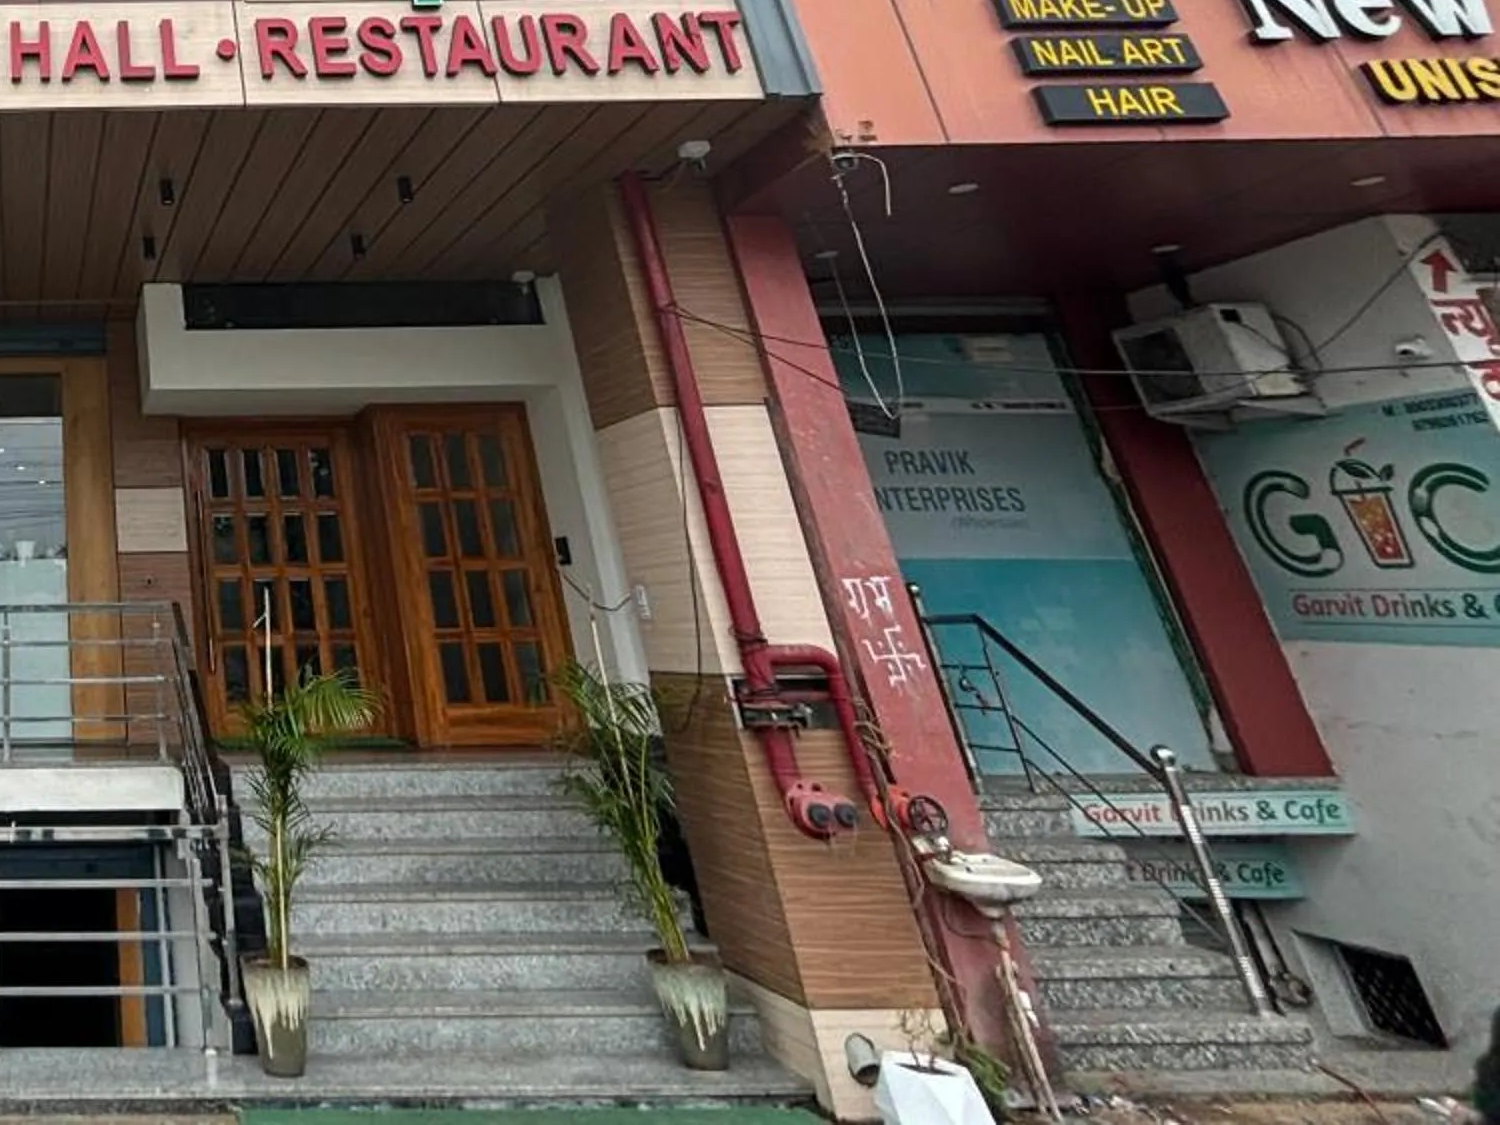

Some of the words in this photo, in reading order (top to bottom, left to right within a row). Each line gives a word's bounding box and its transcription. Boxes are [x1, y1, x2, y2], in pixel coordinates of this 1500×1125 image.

[9, 19, 200, 85] HALL
[255, 11, 742, 78] RESTAURANT
[1031, 37, 1115, 67] NAIL
[1121, 36, 1187, 66] ART
[1087, 86, 1184, 116] HAIR
[884, 450, 975, 475] PRAVIK
[874, 487, 1026, 512] NTERPRISES
[1292, 593, 1365, 617] Garvit
[1371, 593, 1457, 619] Drinks
[1464, 594, 1490, 619] &
[1084, 803, 1162, 823] Garvit
[1256, 800, 1277, 820] &
[1284, 799, 1340, 824] Cafe
[1237, 862, 1285, 887] Cafe
